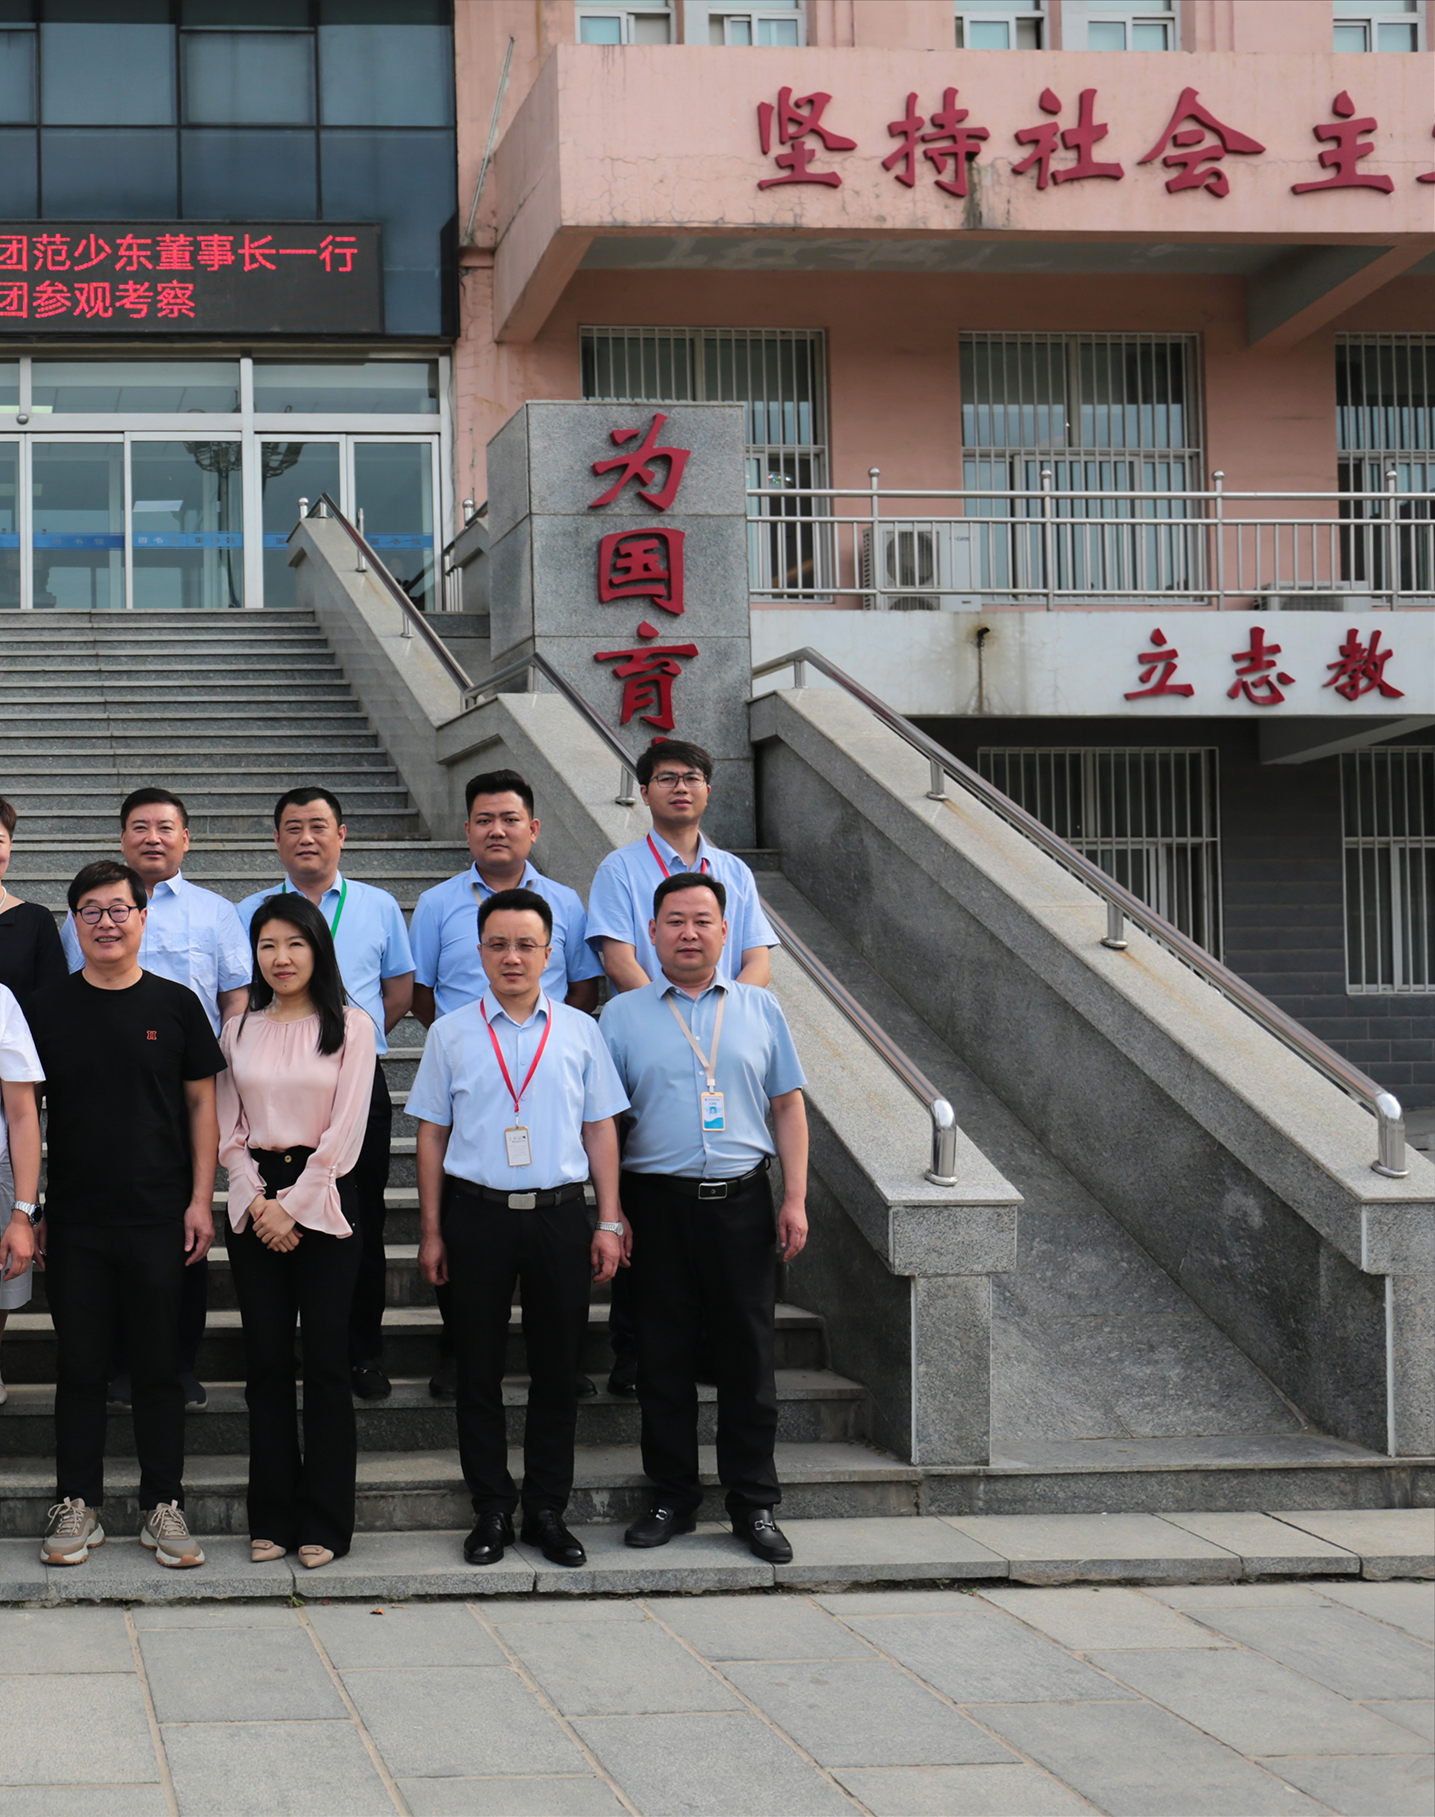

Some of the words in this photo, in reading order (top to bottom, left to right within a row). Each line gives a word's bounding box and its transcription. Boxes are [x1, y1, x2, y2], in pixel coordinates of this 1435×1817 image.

[756, 85, 1435, 201] 坚持社会主
[588, 412, 700, 747] 为国育
[1123, 627, 1406, 706] 立志教
